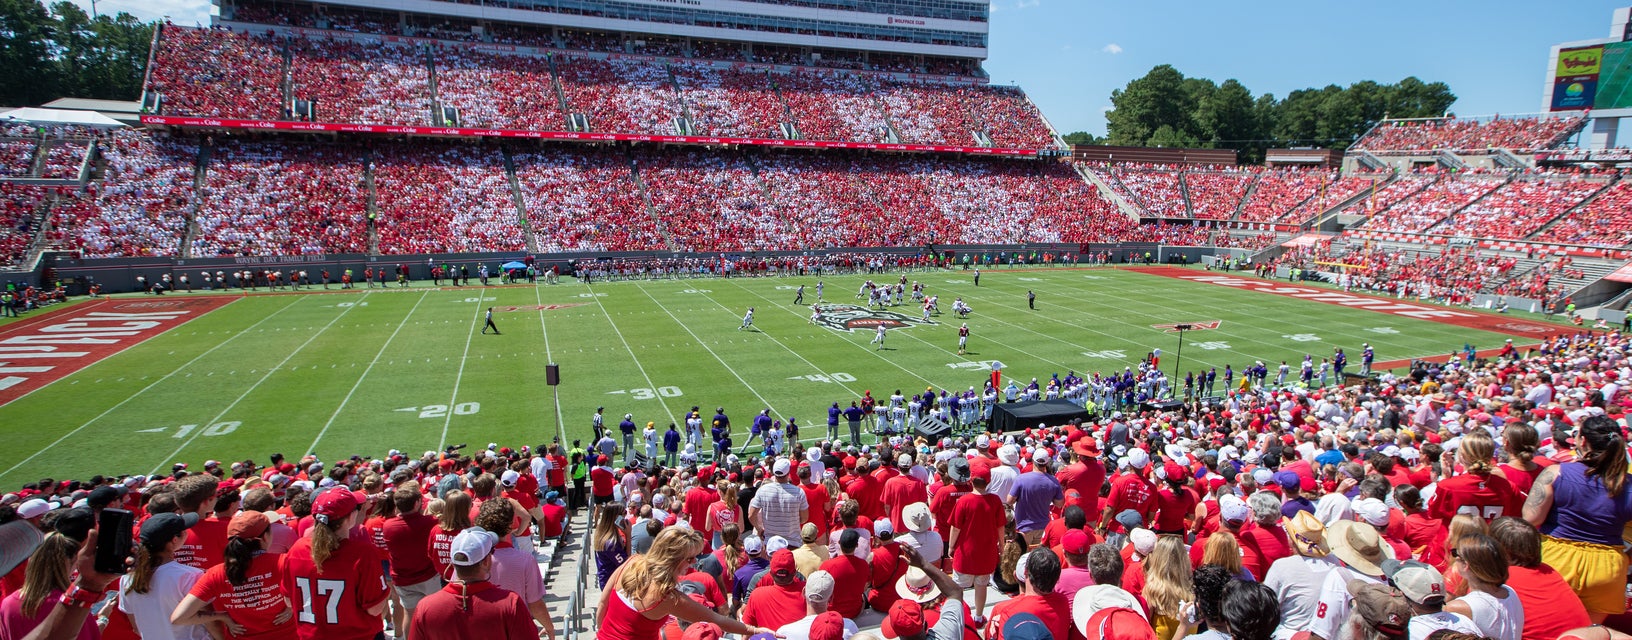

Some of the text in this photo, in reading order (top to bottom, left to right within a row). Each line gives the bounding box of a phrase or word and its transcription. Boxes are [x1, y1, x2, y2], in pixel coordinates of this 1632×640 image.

[803, 372, 857, 383] 40
[630, 386, 683, 399] 30
[418, 401, 481, 419] 20
[172, 420, 242, 438] 10
[616, 552, 624, 563] 5
[233, 582, 264, 591] PHYSICALLY
[380, 574, 388, 590] 1
[232, 588, 260, 597] MENTALLY
[243, 593, 272, 602] WOLFPACK
[296, 576, 345, 624] 17
[1316, 600, 1328, 619] 8
